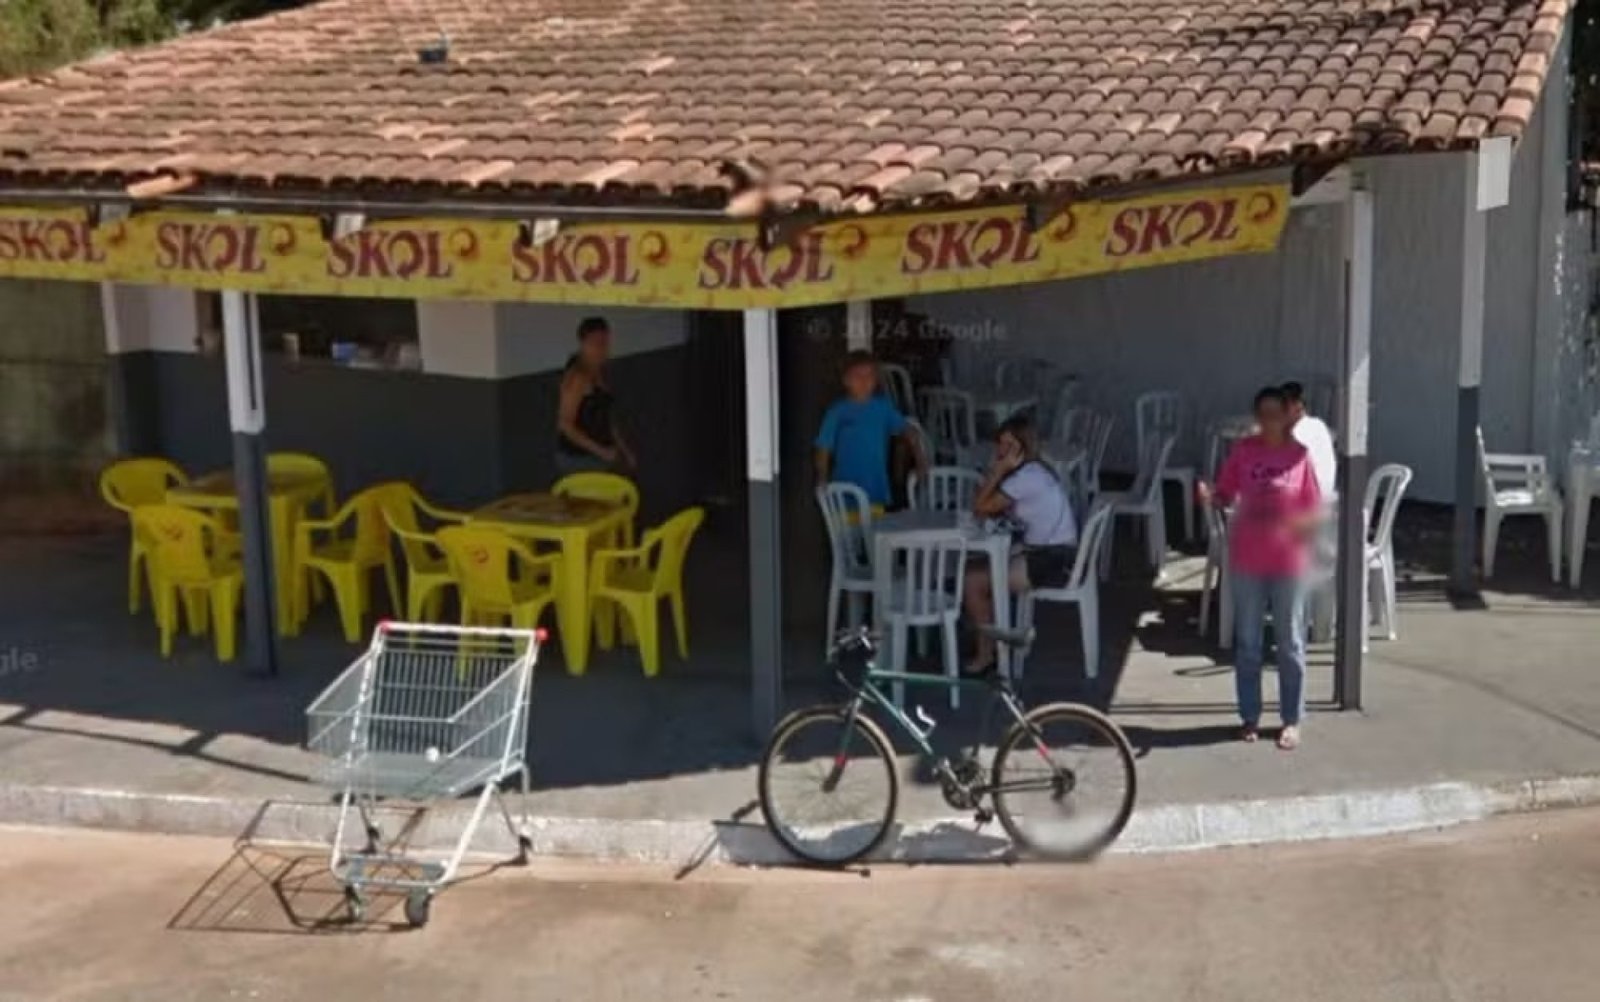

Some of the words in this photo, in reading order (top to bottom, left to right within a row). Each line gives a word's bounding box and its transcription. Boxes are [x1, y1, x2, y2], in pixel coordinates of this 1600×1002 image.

[0, 217, 106, 262] SKOL
[156, 221, 266, 275] SKOL
[326, 229, 453, 281] SKOL
[512, 233, 640, 286] SKOL
[698, 229, 835, 290] SKOL
[901, 216, 1042, 273] SKOL
[1105, 197, 1239, 257] SKOL
